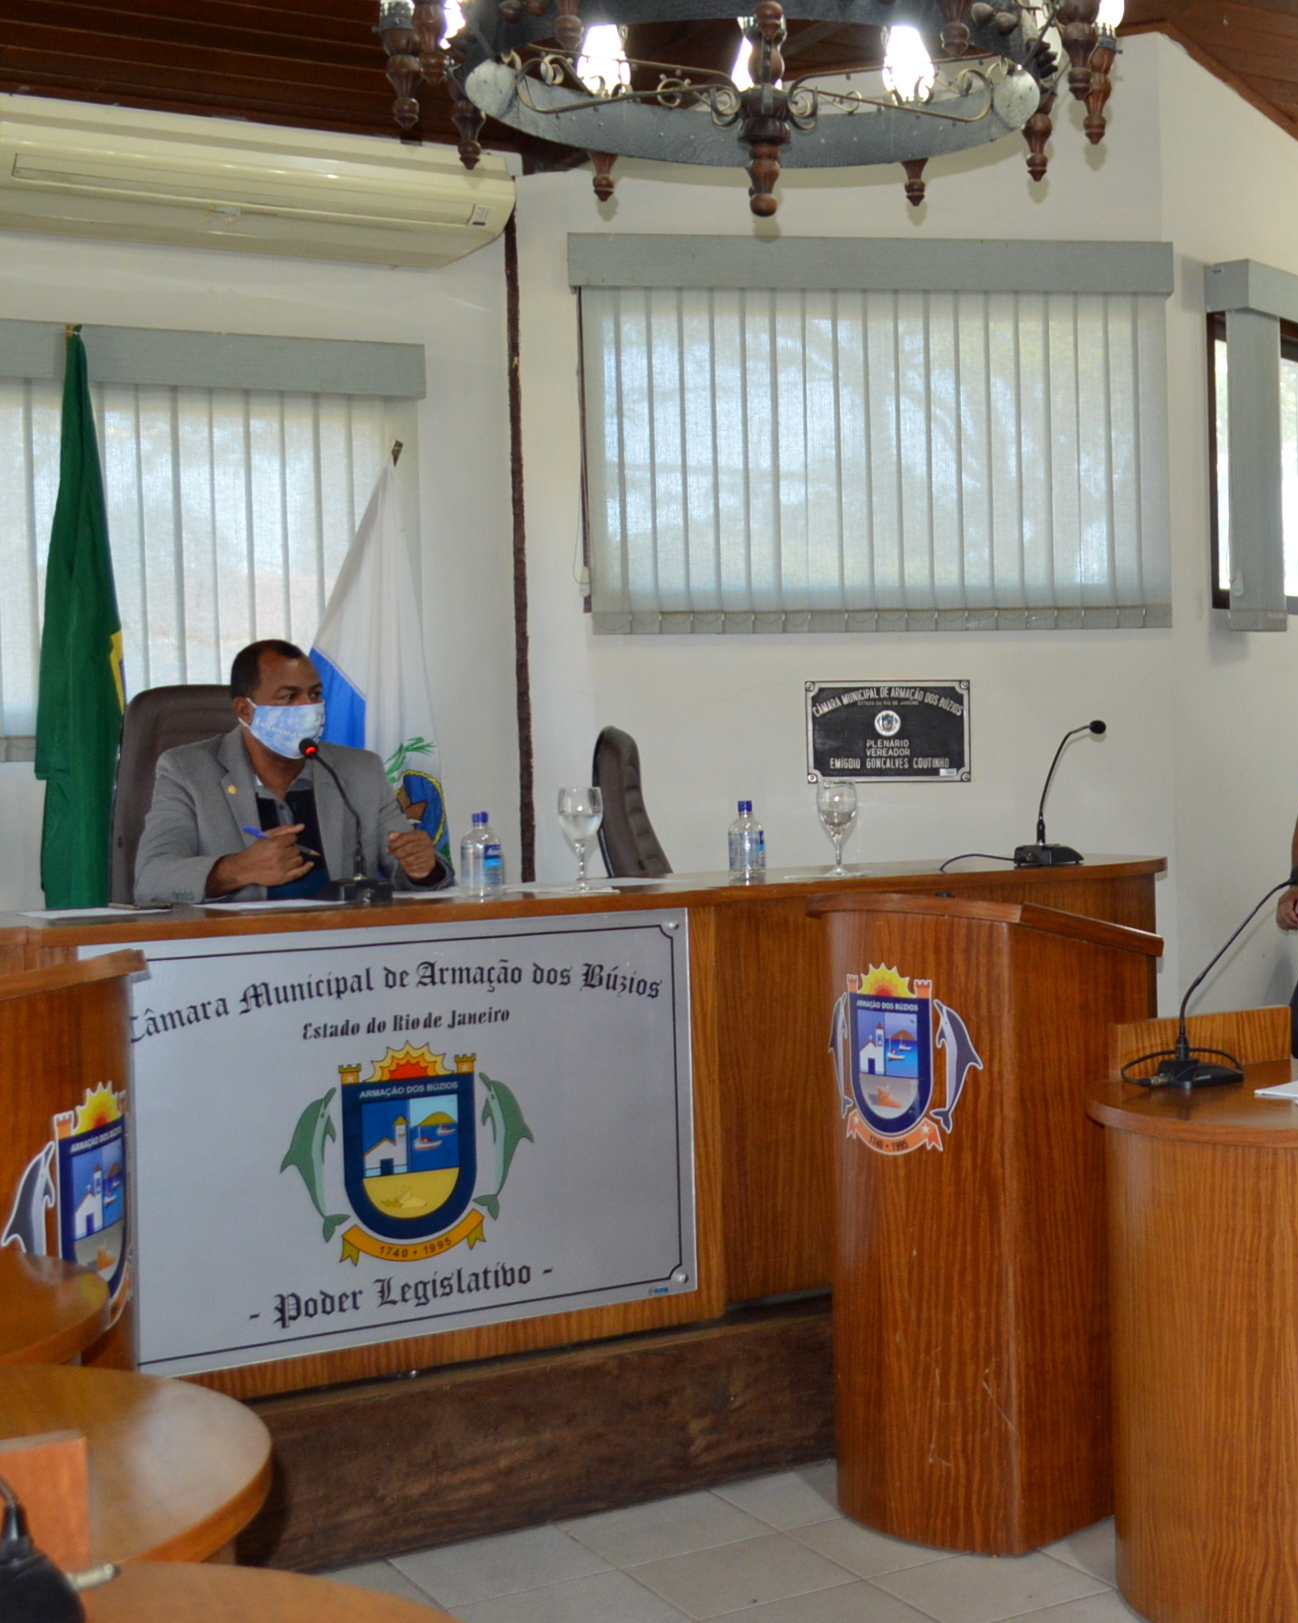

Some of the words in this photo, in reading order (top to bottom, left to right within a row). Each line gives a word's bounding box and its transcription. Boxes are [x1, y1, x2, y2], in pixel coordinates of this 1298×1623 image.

[812, 696, 842, 717] CÂMARA
[841, 687, 879, 706] MUNICIPAL
[880, 687, 890, 698] DE
[891, 688, 924, 702] ARMAÇÃO
[924, 692, 939, 706] DOS
[939, 697, 963, 717] BÚZIOS
[866, 738, 909, 748] PLENÁRIO
[866, 748, 910, 756] VEREADOR
[829, 757, 861, 769] EMÍGDIO
[866, 758, 909, 769] GONÇALVES
[913, 758, 949, 768] COUTINHO
[239, 966, 375, 1016] Municipal
[383, 966, 410, 989] de
[416, 959, 522, 993] Armação
[532, 963, 573, 986] dos
[580, 963, 662, 998] Búzios
[856, 999, 881, 1009] ARMAÇÃO
[881, 1001, 894, 1010] DOS
[895, 1002, 918, 1011] BÚZIOS
[302, 1019, 360, 1040] Estado
[366, 1017, 387, 1034] do
[393, 1012, 420, 1032] Rio
[423, 1011, 442, 1029] de
[447, 1006, 510, 1029] Janeiro
[360, 1086, 405, 1099] ARMAÇÃO
[406, 1083, 425, 1094] DOS
[427, 1081, 458, 1091] BÚZIOS
[380, 1245, 409, 1258] 1740
[423, 1236, 452, 1255] 1995
[273, 1288, 363, 1328] Poder
[374, 1261, 532, 1307] Legislativo
